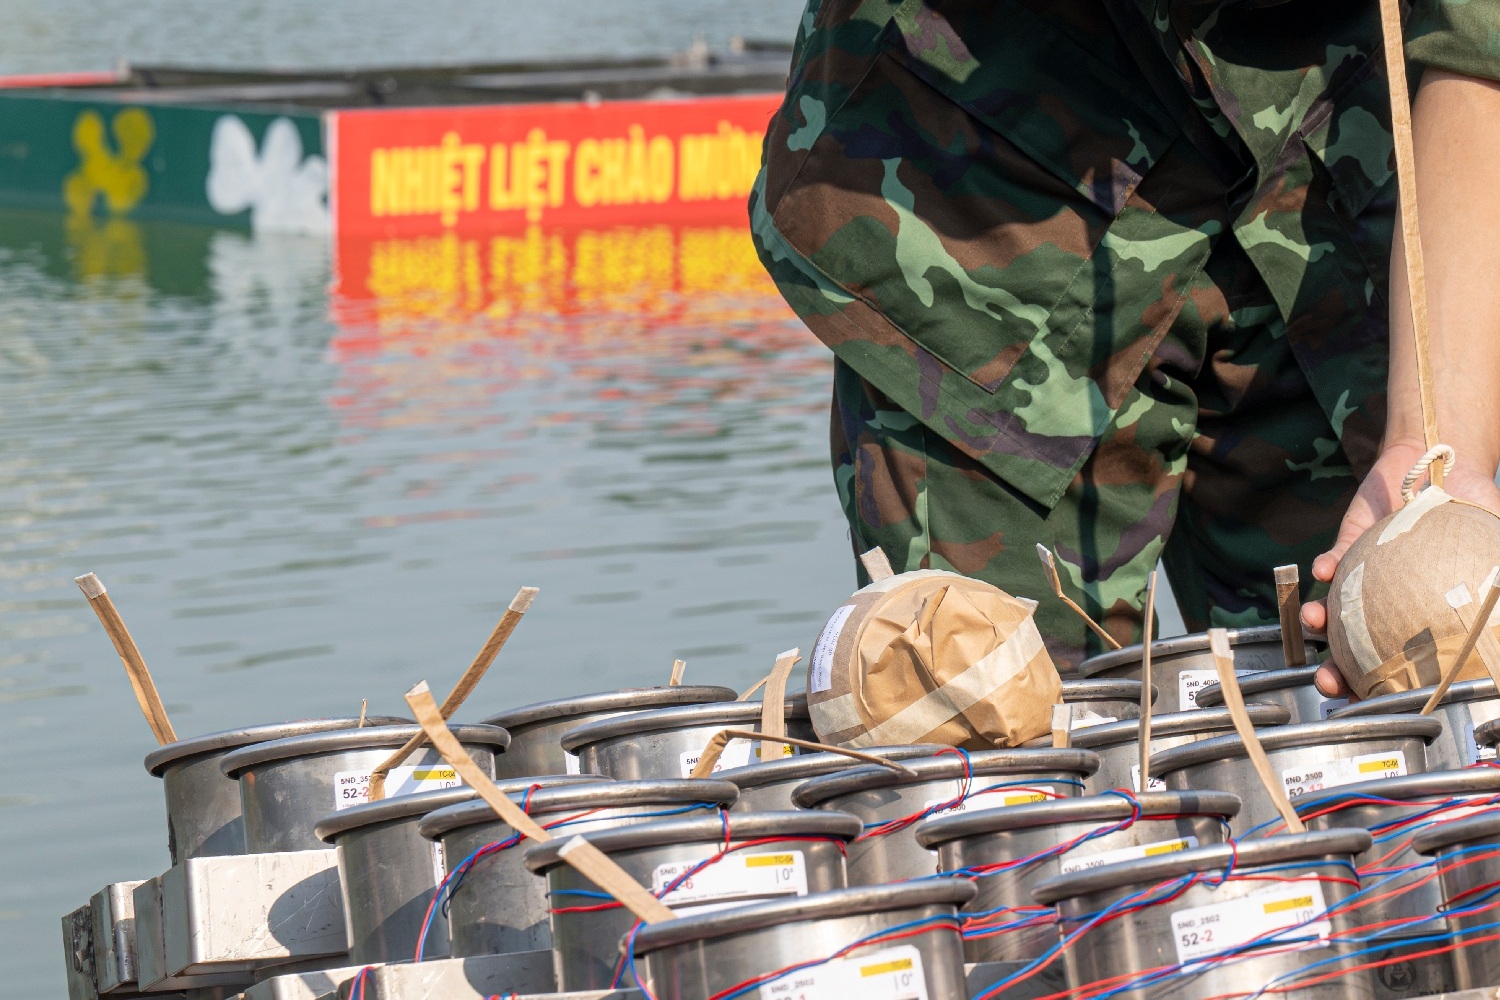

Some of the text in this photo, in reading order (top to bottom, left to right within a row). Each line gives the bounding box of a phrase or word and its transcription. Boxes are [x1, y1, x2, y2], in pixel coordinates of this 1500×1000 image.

[370, 130, 486, 227] NHIỆT
[489, 127, 570, 223] LIỆT
[573, 124, 674, 207] CHÀO
[438, 769, 456, 778] TC-04
[1181, 929, 1214, 948] 52-2
